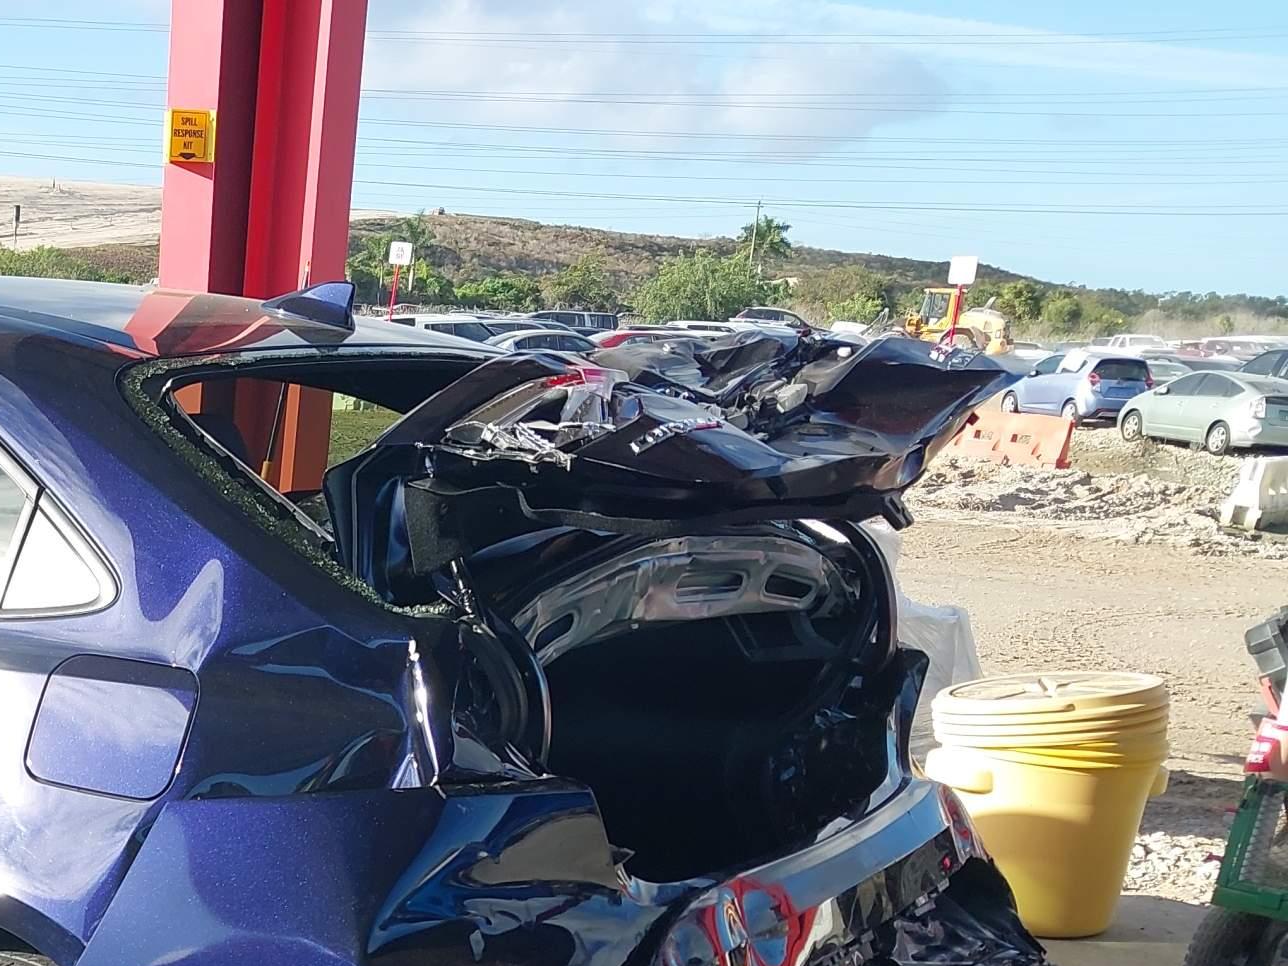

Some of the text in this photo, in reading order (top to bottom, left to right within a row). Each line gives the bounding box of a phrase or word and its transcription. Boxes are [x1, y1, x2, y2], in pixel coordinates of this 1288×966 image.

[181, 117, 197, 126] SPILL
[174, 129, 204, 138] RESPONSE
[183, 141, 193, 150] KIT
